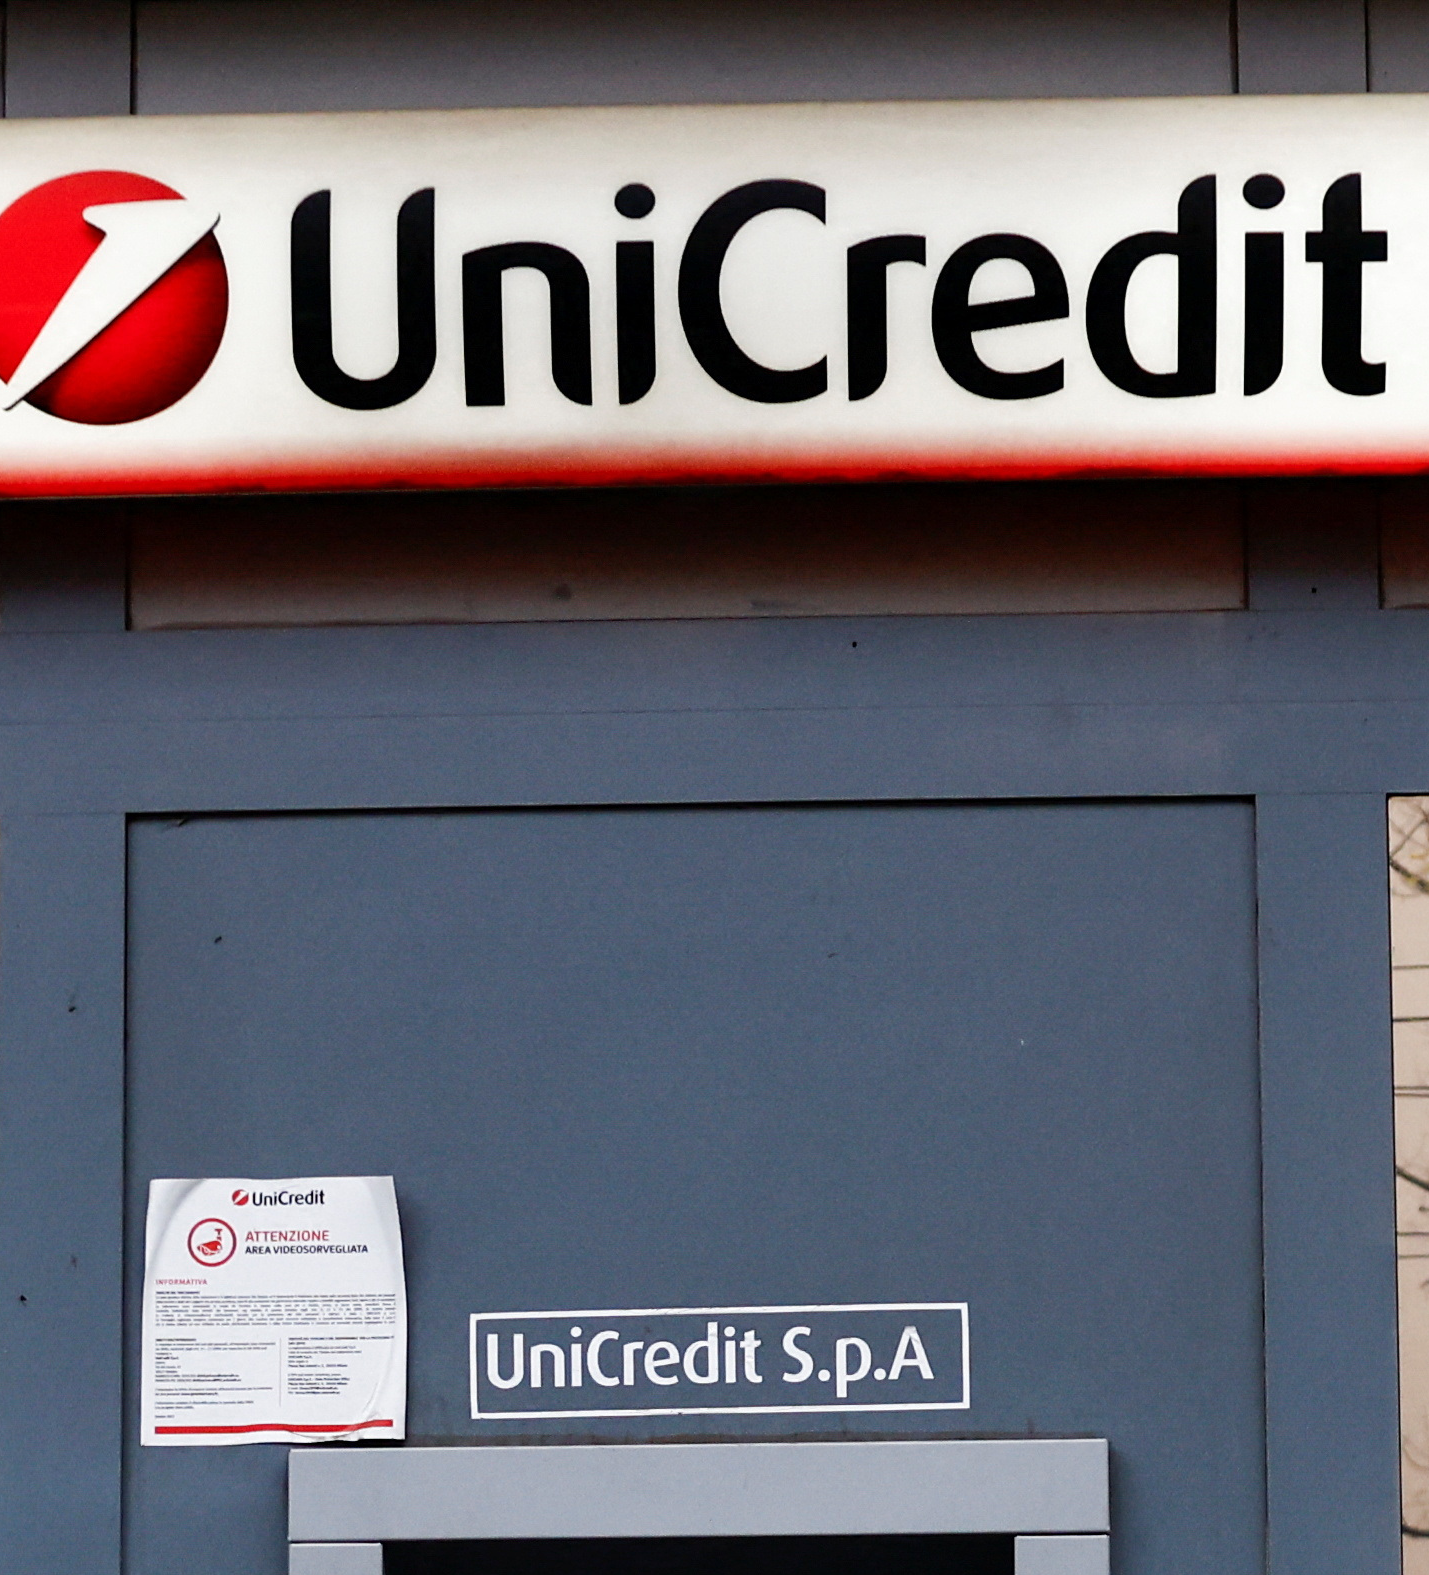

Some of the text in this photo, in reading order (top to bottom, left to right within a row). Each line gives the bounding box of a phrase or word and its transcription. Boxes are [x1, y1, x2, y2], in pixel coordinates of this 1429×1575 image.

[290, 172, 1388, 411] UniCredit
[252, 1189, 325, 1206] UniCredit
[245, 1229, 329, 1242] ATTENZIONE
[245, 1244, 369, 1255] AREA VIDEOSORVEGLIATA
[155, 1278, 208, 1286] INFORMATIVA
[486, 1321, 935, 1399] UniCredit S.p.A
